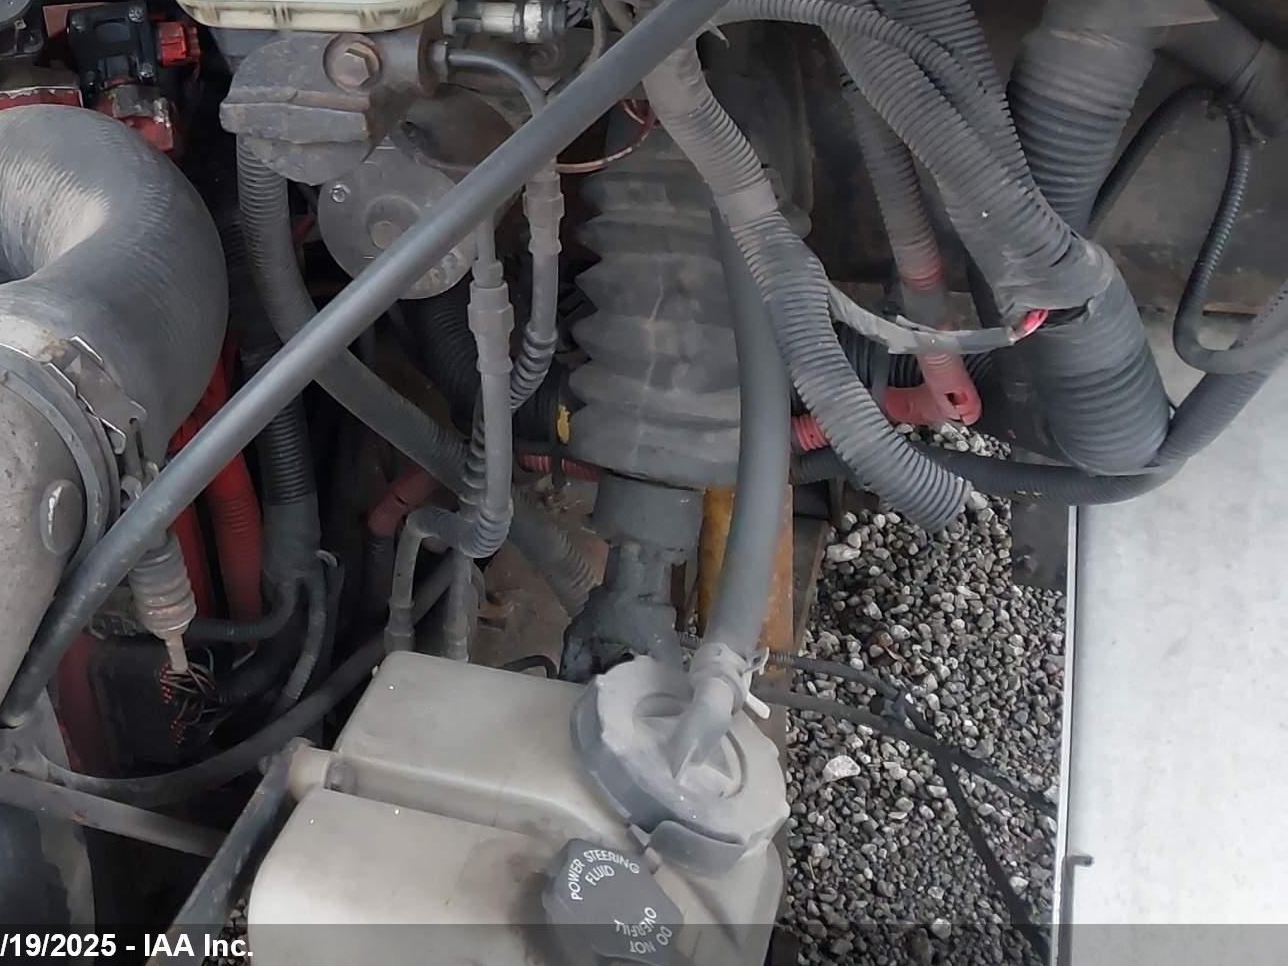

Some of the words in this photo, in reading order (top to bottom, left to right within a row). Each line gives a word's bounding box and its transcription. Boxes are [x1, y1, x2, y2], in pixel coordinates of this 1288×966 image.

[568, 859, 586, 901] POWER
[583, 849, 640, 874] STEERING
[585, 865, 615, 886] FLUID
[613, 907, 657, 938] OVERFILL
[655, 926, 673, 946] DO
[629, 940, 657, 954] NOT
